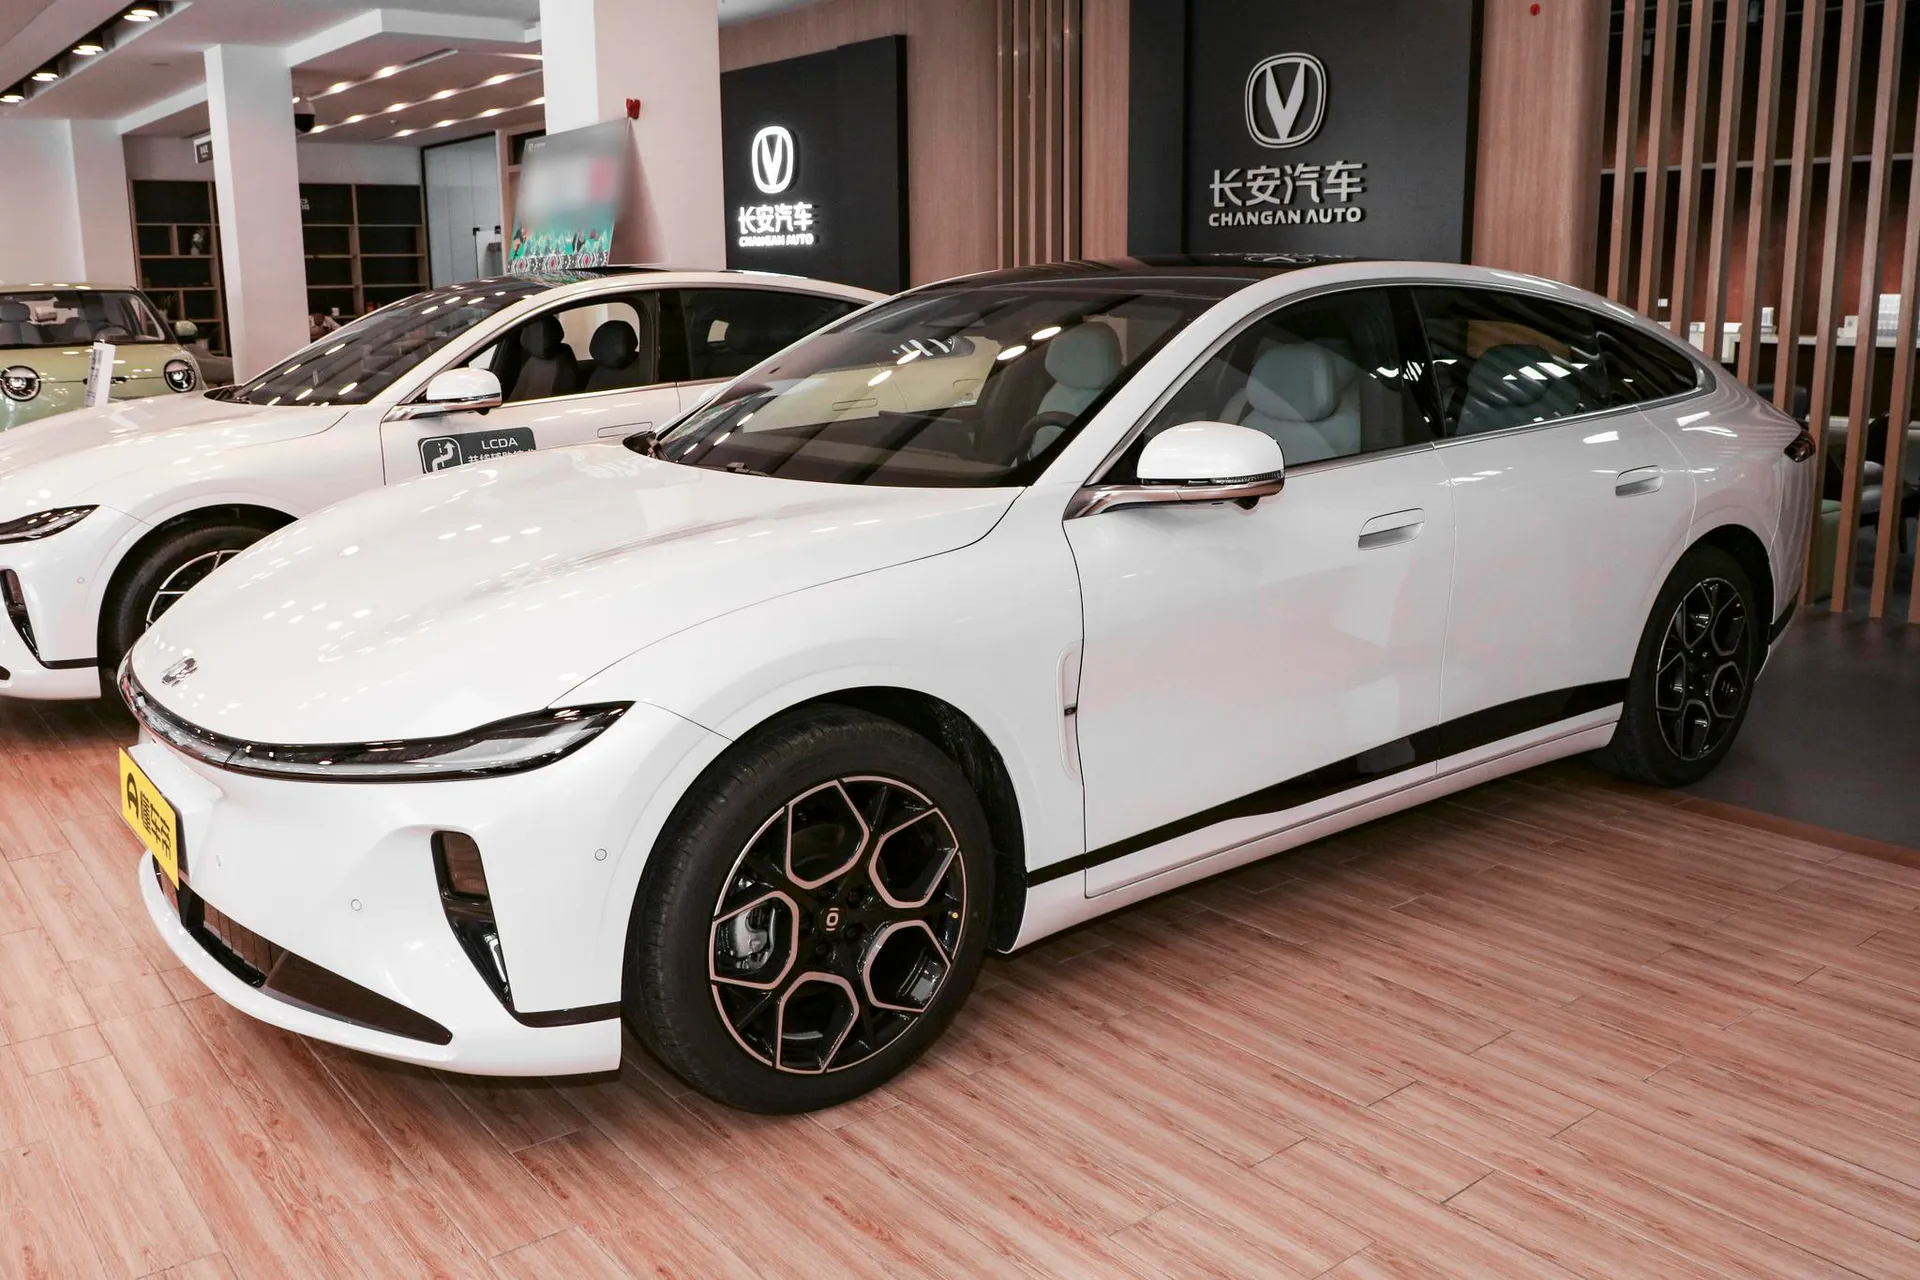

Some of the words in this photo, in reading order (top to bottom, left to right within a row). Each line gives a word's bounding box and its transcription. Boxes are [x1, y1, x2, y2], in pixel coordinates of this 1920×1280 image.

[1209, 160, 1363, 207] 长安汽车
[738, 201, 813, 234] 长安汽车
[1208, 209, 1301, 227] CHANGAN
[1306, 207, 1362, 223] AUTO
[481, 437, 518, 449] LCDA
